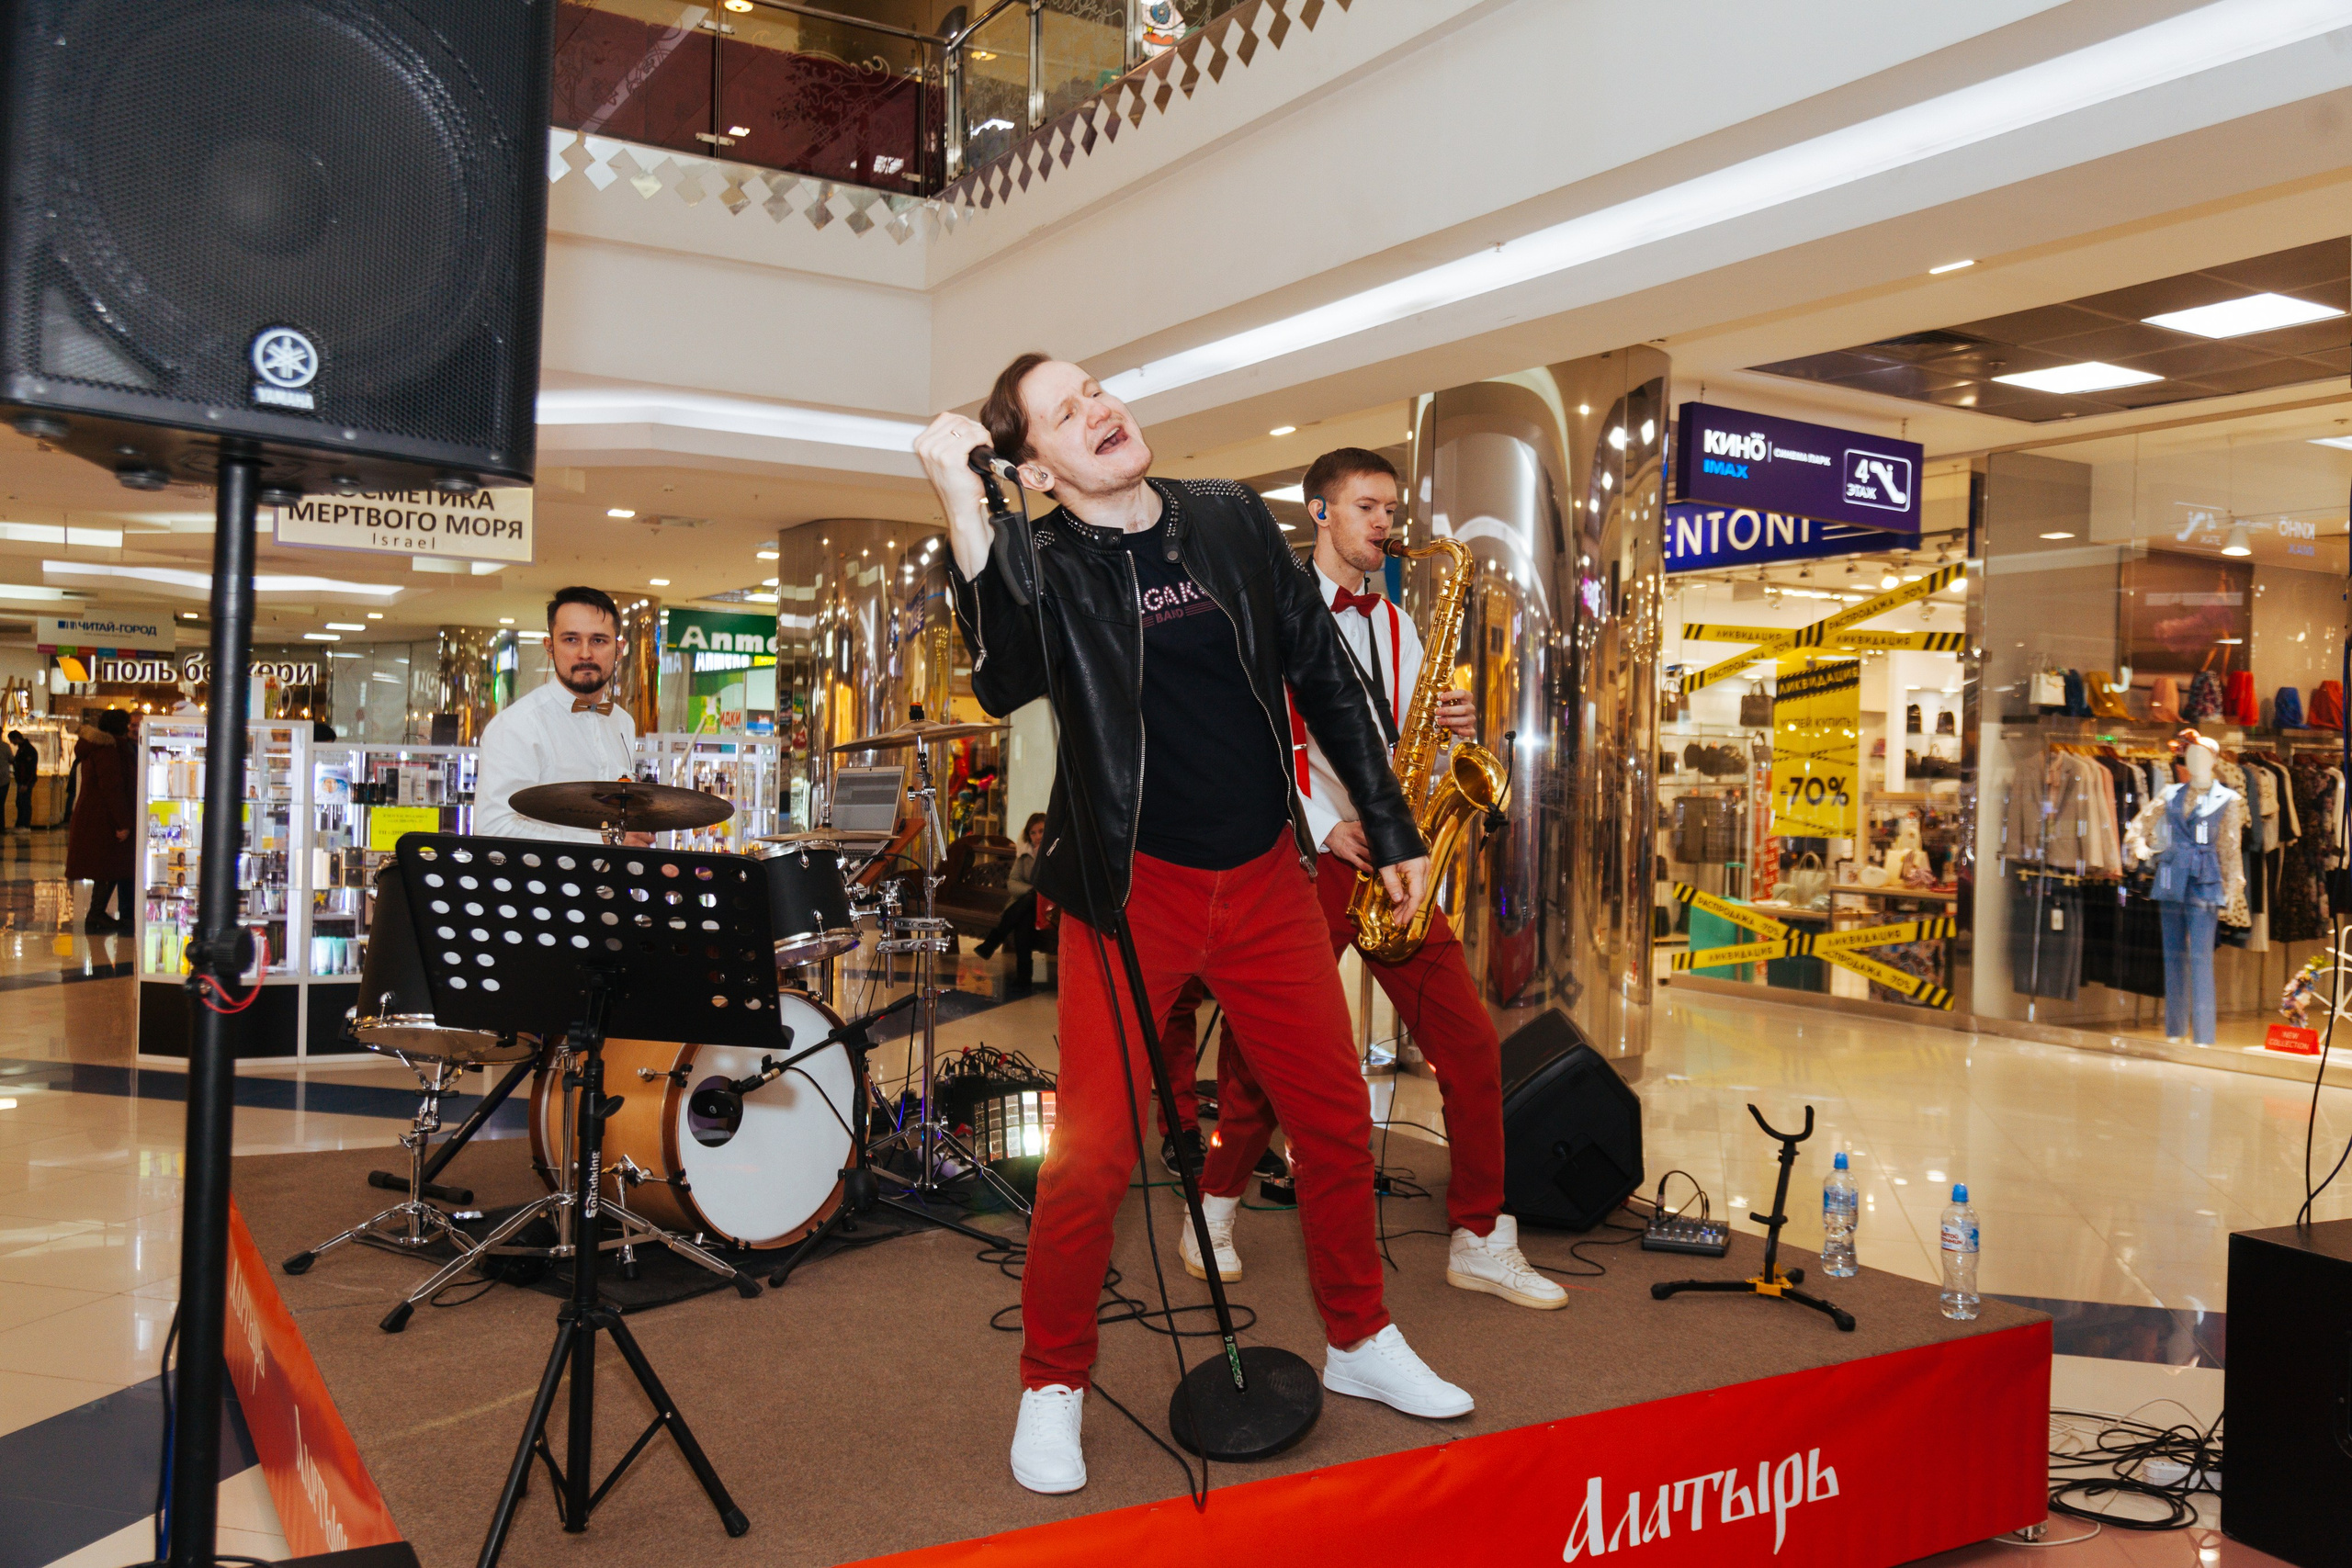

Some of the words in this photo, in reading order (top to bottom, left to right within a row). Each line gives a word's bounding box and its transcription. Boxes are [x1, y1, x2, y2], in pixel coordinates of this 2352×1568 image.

[1703, 457, 1749, 479] IMAX
[1854, 458, 1871, 484] 4
[1846, 482, 1877, 501] ЭТАЖ
[288, 502, 437, 533] МЕРТВОГО
[446, 513, 523, 540] МОРЯ
[373, 532, 435, 549] Israel
[1156, 608, 1185, 624] BAND
[1827, 597, 1896, 630] РАСПРОДАЖА
[78, 621, 158, 637] ЧИТАЙ-ГОРОД
[1716, 629, 1782, 641] ЛИКВИДАЦИЯ
[1837, 634, 1911, 646] ЛИКВИДАЦИЯ
[102, 659, 178, 684] поль
[1777, 665, 1859, 694] ЛИКВИДАЦИЯ
[1780, 776, 1849, 807] -70%
[1697, 896, 1755, 925] РАСПРОДАЖА
[1826, 930, 1902, 946] ЛИКВИДАЦИЯ
[1709, 946, 1774, 962] ЛИКВИДАЦИЯ
[2268, 1038, 2310, 1050] COLLECTION
[2282, 1031, 2300, 1040] NEW
[585, 1150, 601, 1218] Soundking
[1562, 1447, 1839, 1563] Алатырь
